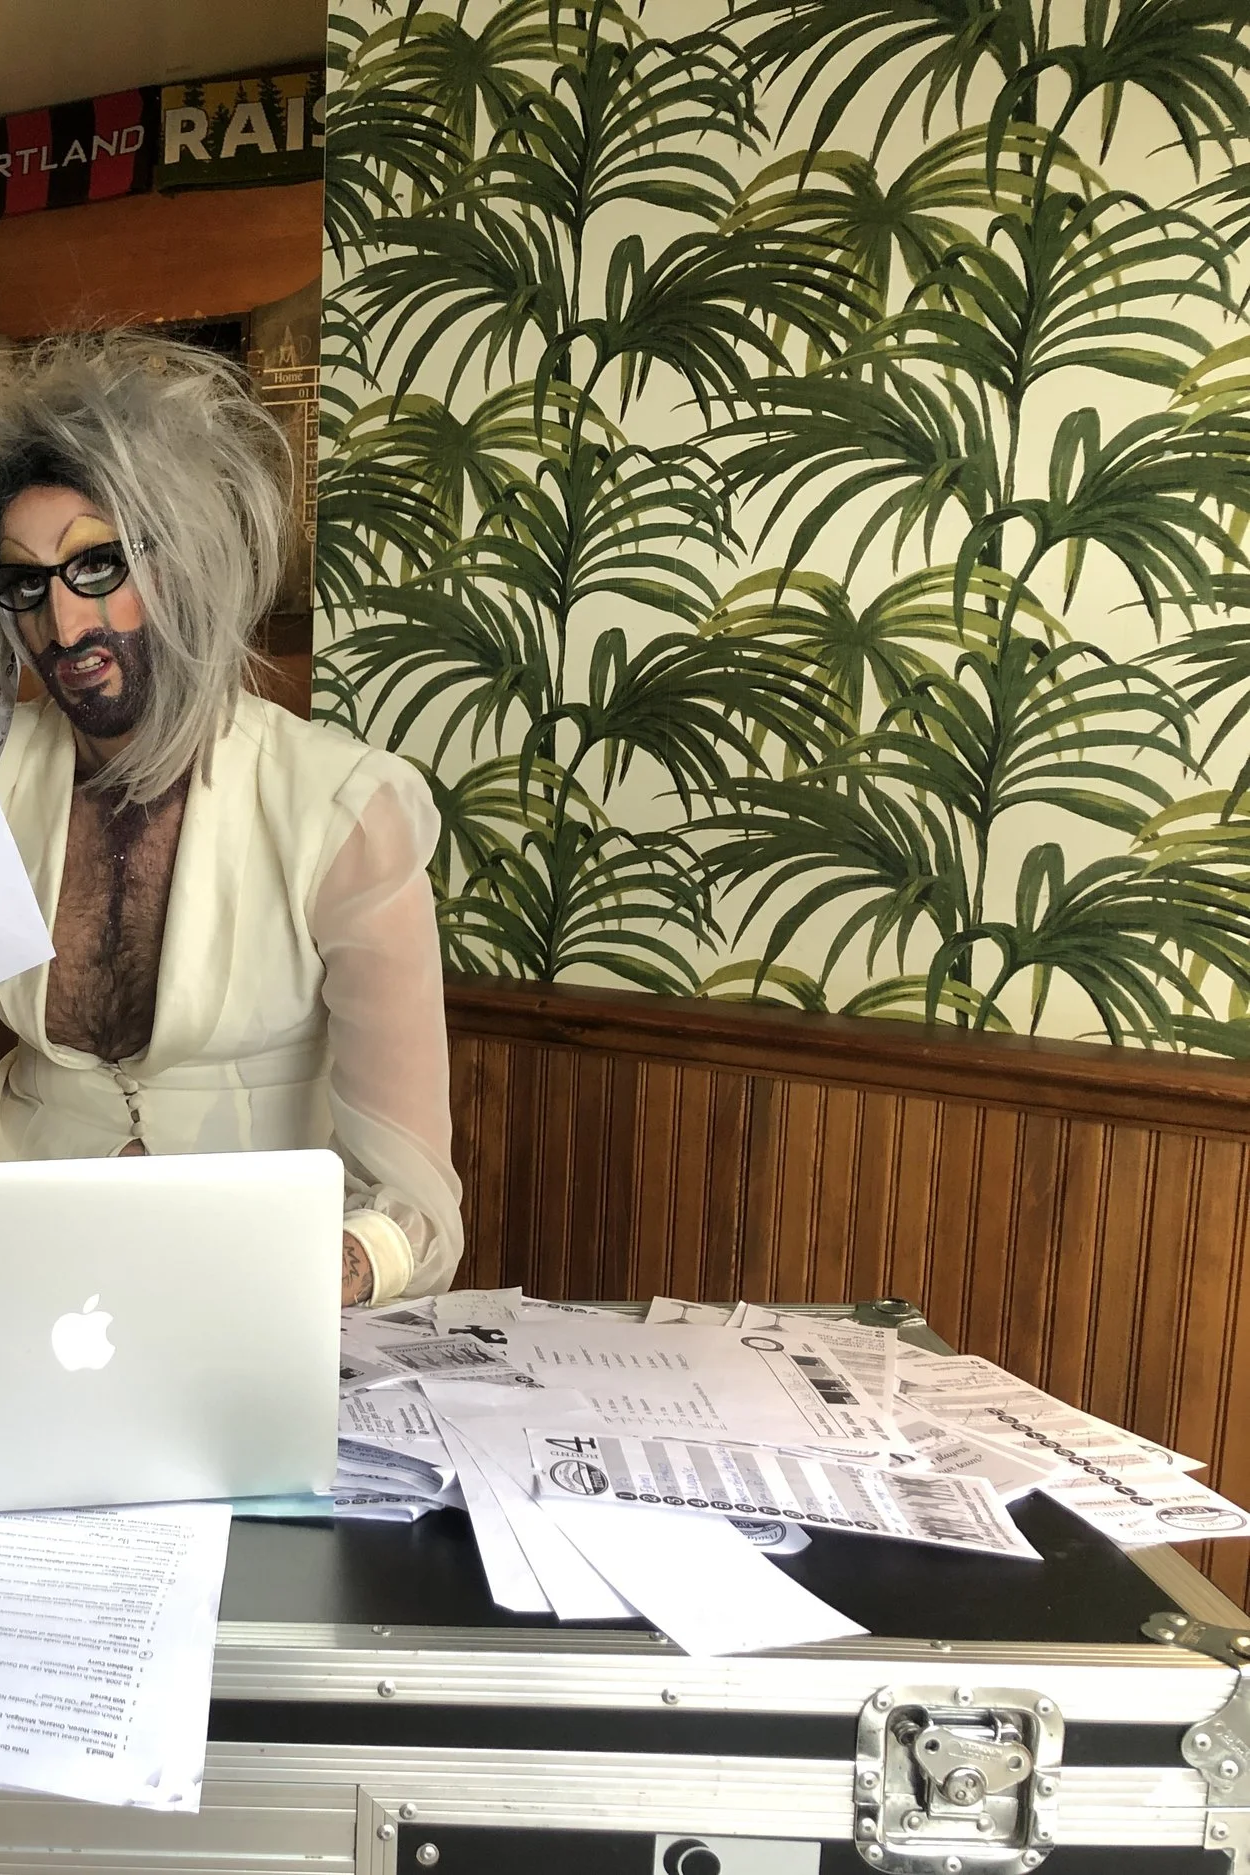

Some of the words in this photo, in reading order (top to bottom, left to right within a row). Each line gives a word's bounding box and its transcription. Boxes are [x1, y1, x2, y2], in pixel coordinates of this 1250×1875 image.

[274, 372, 303, 384] Home
[545, 1436, 597, 1453] 4
[87, 1657, 105, 1666] Curry
[106, 1661, 133, 1671] Stephen
[82, 1674, 102, 1682] which
[89, 1692, 111, 1701] Ferrell
[111, 1696, 125, 1704] Will
[40, 1701, 52, 1709] and
[53, 1703, 71, 1712] actor
[3, 1711, 36, 1724] Michigan,
[100, 1712, 122, 1720] Which
[6, 1722, 28, 1733] there?
[37, 1718, 65, 1730] Ontario,
[66, 1723, 89, 1734] Huron,
[41, 1729, 59, 1738] Lakes
[60, 1732, 79, 1742] Great
[90, 1727, 112, 1739] (Note:
[81, 1735, 99, 1744] many
[100, 1740, 115, 1748] How
[11, 1745, 30, 1754] Trivia
[85, 1746, 90, 1754] 5
[90, 1747, 114, 1759] Round
